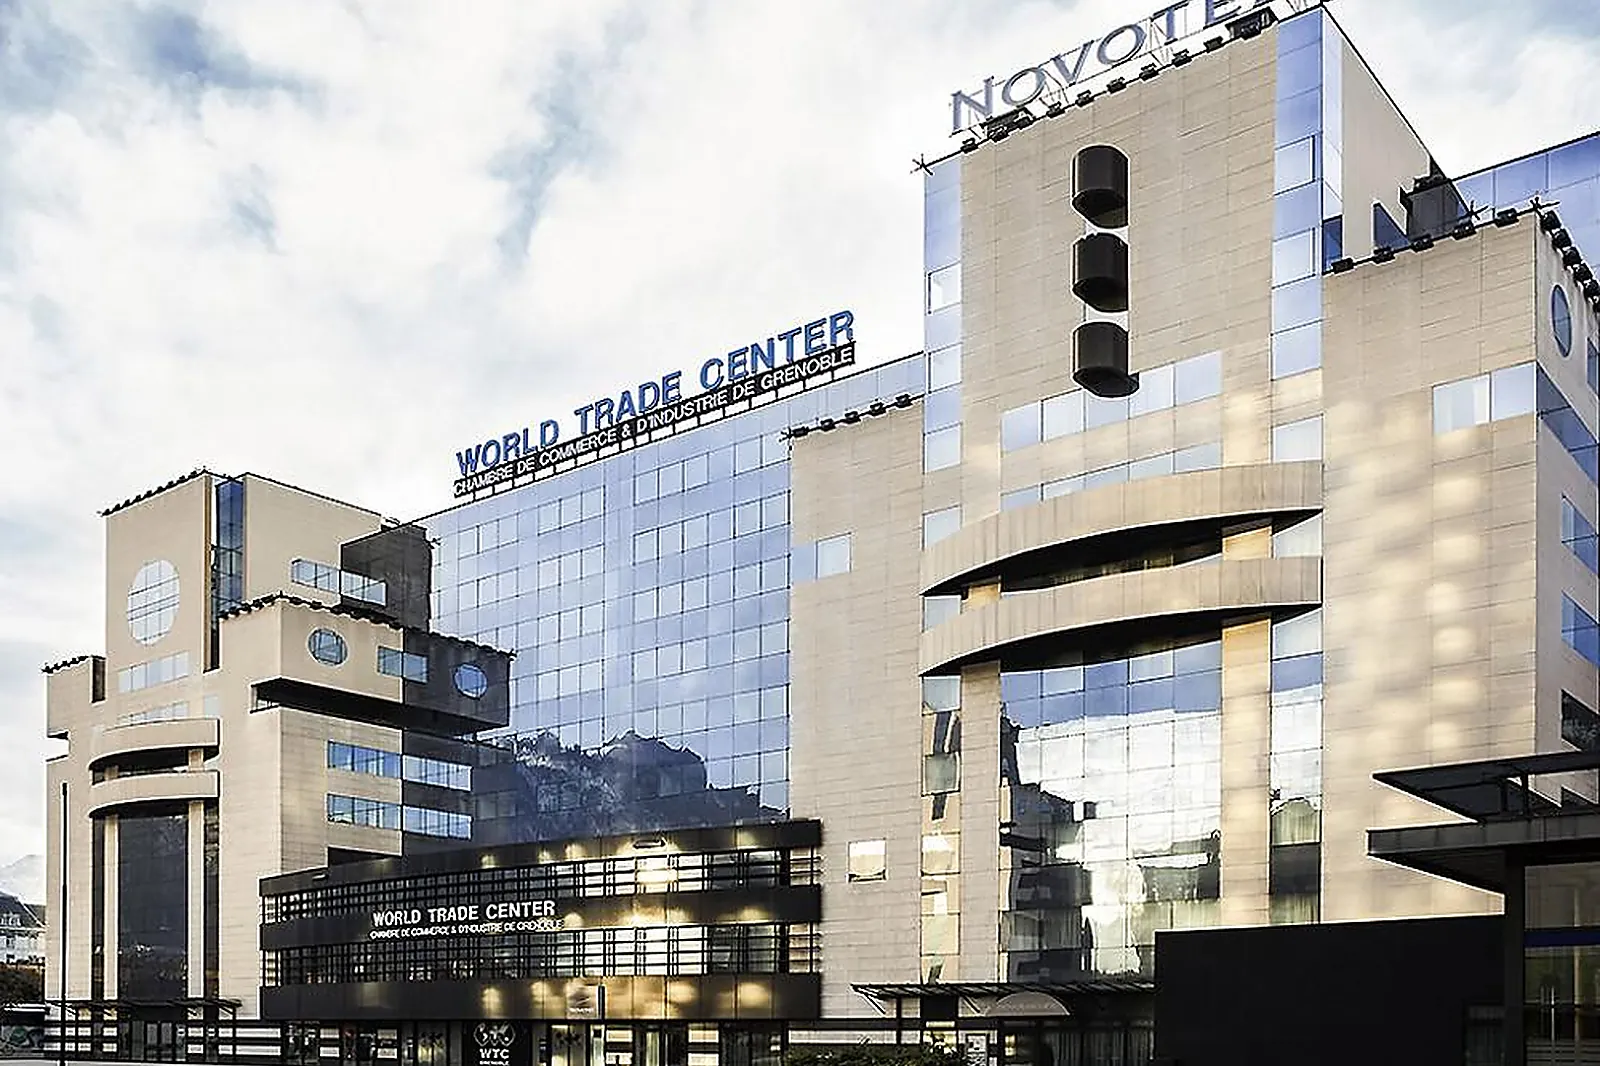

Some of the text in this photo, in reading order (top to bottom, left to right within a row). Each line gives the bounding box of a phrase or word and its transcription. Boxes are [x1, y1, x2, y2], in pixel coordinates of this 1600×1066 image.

[950, 0, 1282, 132] NOVOTE
[453, 463, 515, 497] CHAMBRE
[516, 456, 536, 475] DE
[538, 428, 618, 466] COMMERCE
[620, 423, 632, 439] &
[732, 379, 756, 401] DE
[760, 346, 853, 389] GRENOBLE
[455, 309, 855, 477] WORLD TRADE CENTER
[372, 899, 557, 928] WORLD TRADE CENTER
[479, 1047, 510, 1060] WTC
